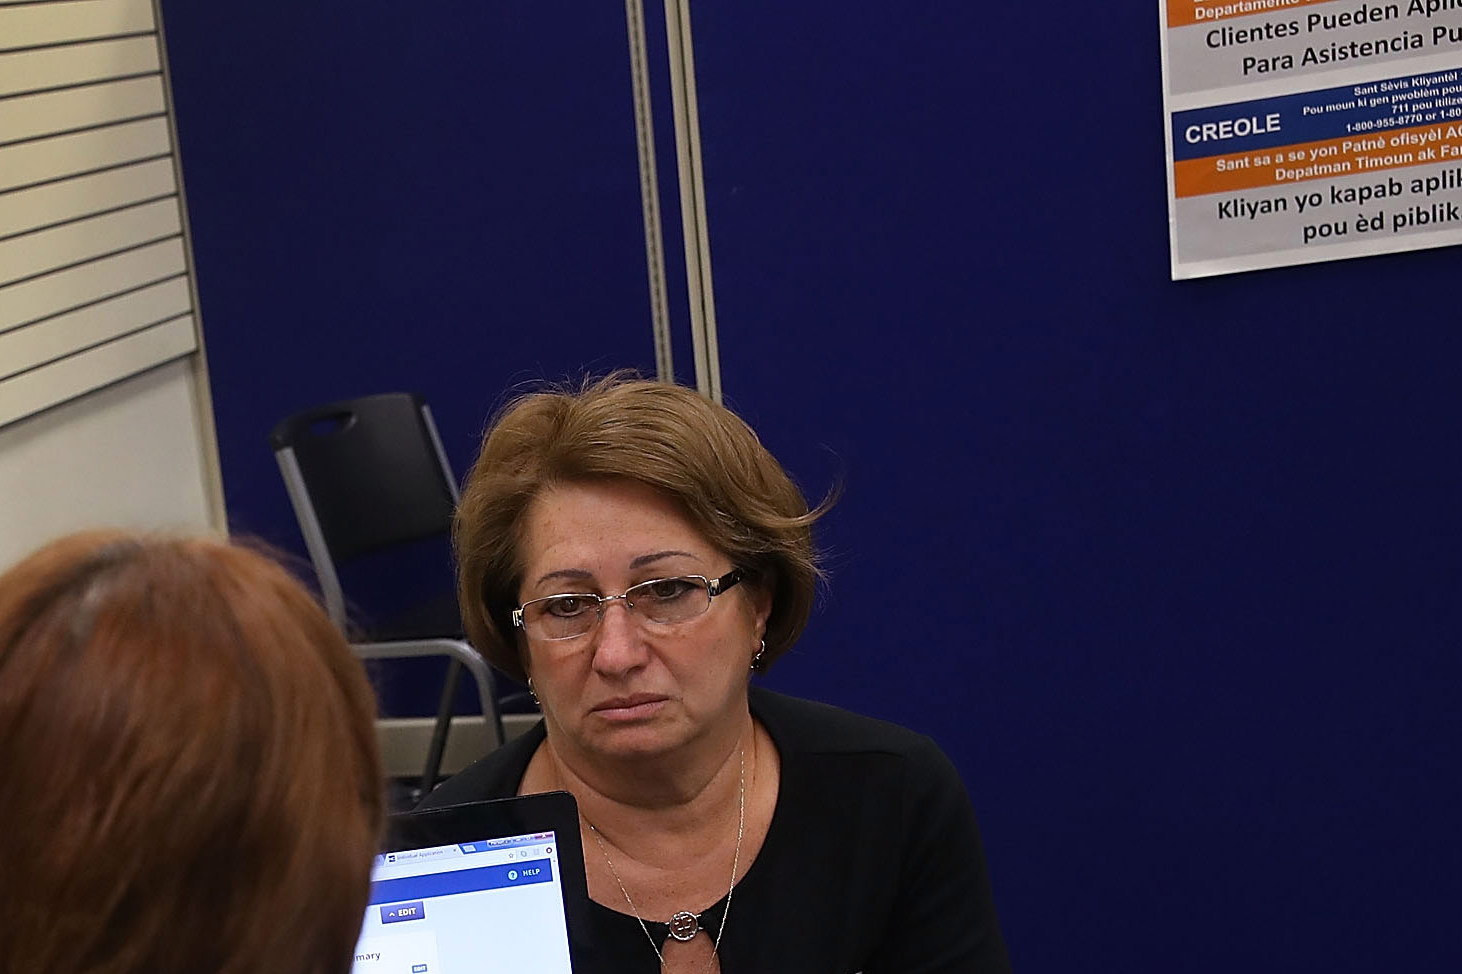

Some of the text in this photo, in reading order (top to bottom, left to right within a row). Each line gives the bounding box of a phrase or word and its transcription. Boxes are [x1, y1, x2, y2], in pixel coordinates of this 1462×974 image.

[1206, 20, 1299, 48] Clientes
[1307, 4, 1398, 32] Pueden
[1243, 54, 1293, 75] Para
[1302, 31, 1423, 66] Asistencia
[1303, 105, 1323, 115] Pou
[1326, 101, 1355, 112] moun
[1358, 98, 1367, 107] ki
[1369, 96, 1389, 108] gen
[1442, 85, 1462, 96] pou
[1354, 85, 1378, 96] Sant
[1392, 103, 1409, 114] 711
[1412, 100, 1432, 112] pou
[1185, 113, 1281, 143] CREOLE
[1425, 112, 1436, 121] or
[1216, 156, 1250, 172] Sant
[1253, 155, 1271, 167] sa
[1275, 153, 1284, 163] a
[1288, 151, 1305, 161] se
[1310, 146, 1338, 161] yon
[1275, 144, 1462, 180] Depatman Timoun ak Fa
[1218, 198, 1287, 219] Kliyan
[1295, 193, 1322, 213] yo
[1331, 177, 1402, 205] kapab
[1304, 221, 1347, 243] pou
[1356, 211, 1384, 232] èd
[522, 868, 540, 877] HELP
[398, 907, 417, 917] EDIT
[354, 951, 381, 962] mary
